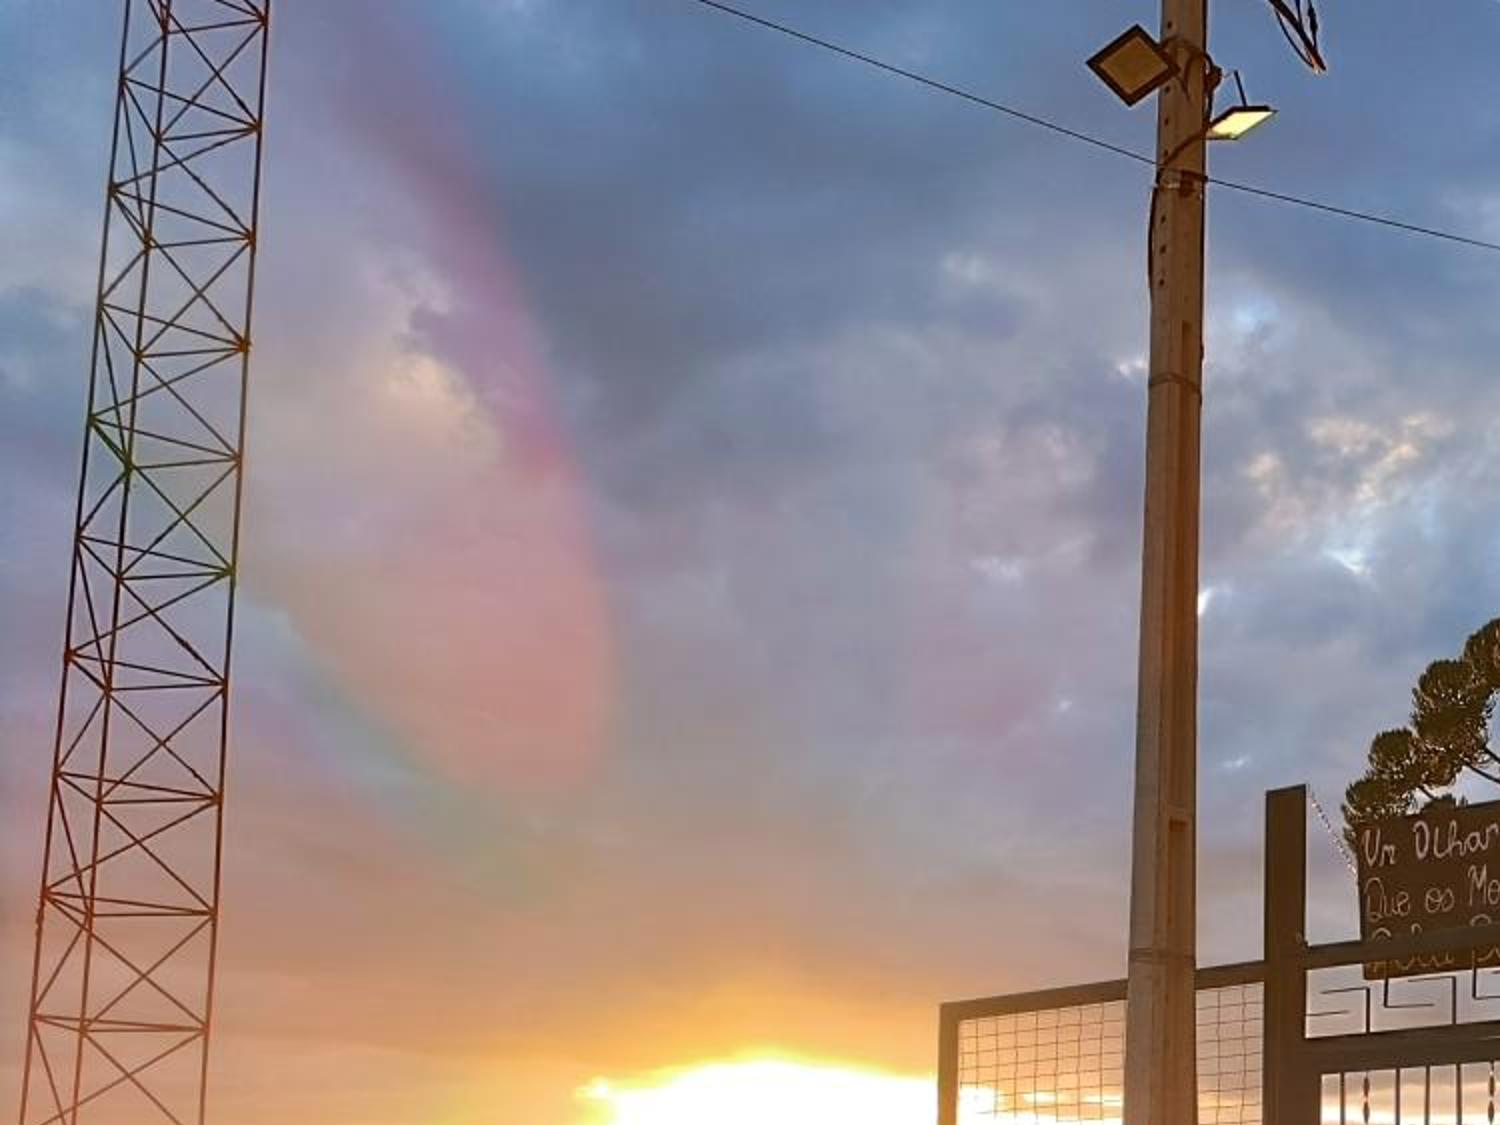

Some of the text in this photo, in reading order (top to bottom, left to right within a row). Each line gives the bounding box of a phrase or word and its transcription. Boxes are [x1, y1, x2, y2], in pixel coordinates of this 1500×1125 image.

[1413, 820, 1499, 860] Olhar
[1363, 877, 1411, 922] Que
[1425, 887, 1455, 913] os
